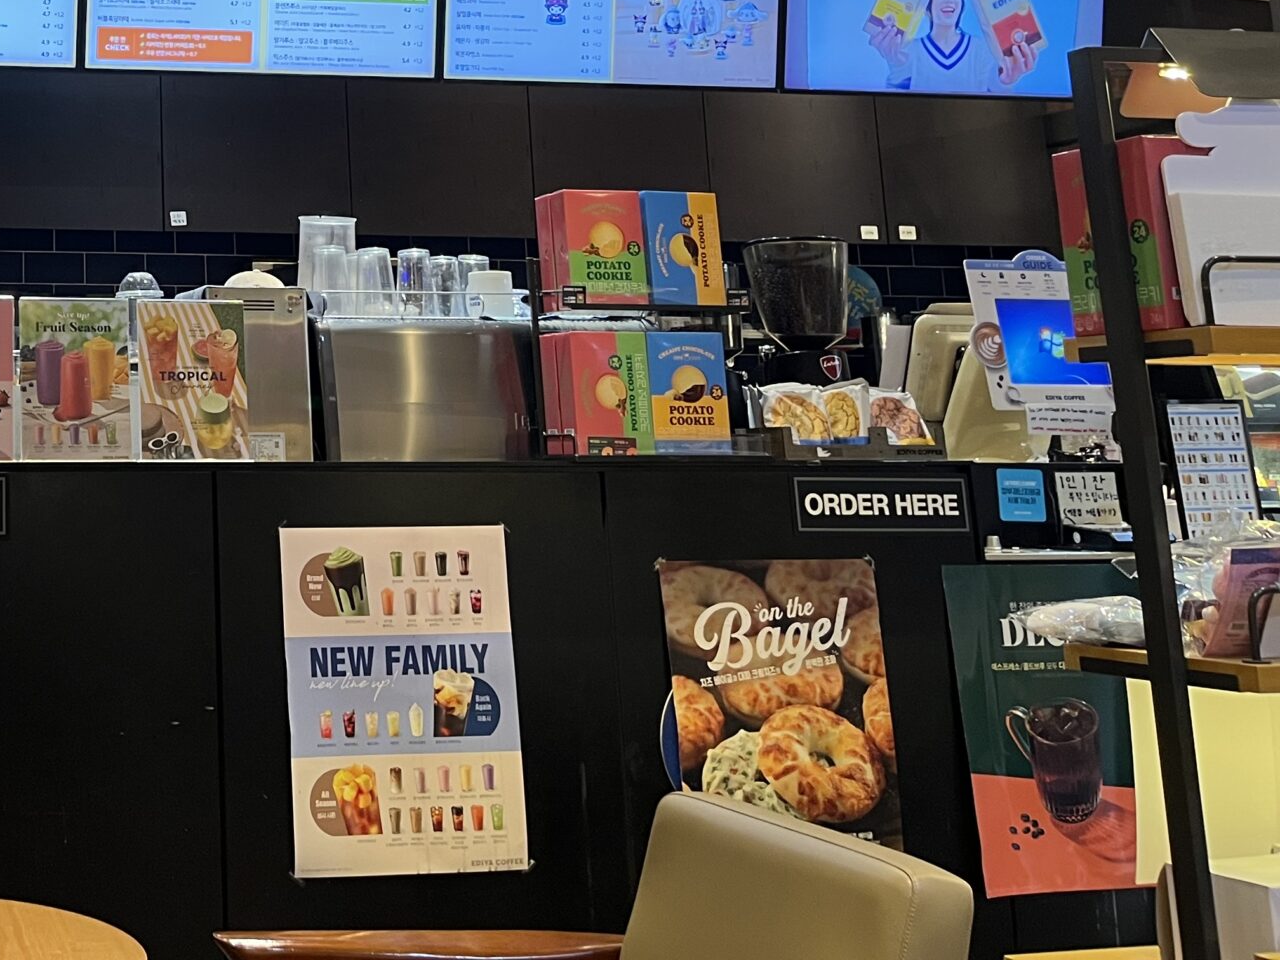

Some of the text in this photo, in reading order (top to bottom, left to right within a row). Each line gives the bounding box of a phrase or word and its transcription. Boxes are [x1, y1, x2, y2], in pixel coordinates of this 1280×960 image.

[1133, 226, 1147, 238] 24
[697, 214, 710, 288] POTATO COOKIE
[586, 260, 631, 270] POTATO
[1022, 261, 1053, 270] GUIDE
[586, 271, 632, 281] COOKIE
[35, 321, 112, 332] Fruit Season
[158, 371, 227, 382] TROPICAL
[625, 354, 638, 432] POTATO COOKIE
[669, 405, 714, 415] POTATO
[669, 416, 716, 426] COOKIE
[1059, 475, 1078, 489] 1인
[804, 492, 960, 516] ORDER HERE
[759, 596, 815, 622] on the
[693, 597, 852, 676] Bagel
[309, 643, 489, 678] NEW FAMILY
[309, 677, 338, 690] new
[340, 670, 370, 690] line
[471, 858, 524, 867] EDIYA COFFEE
